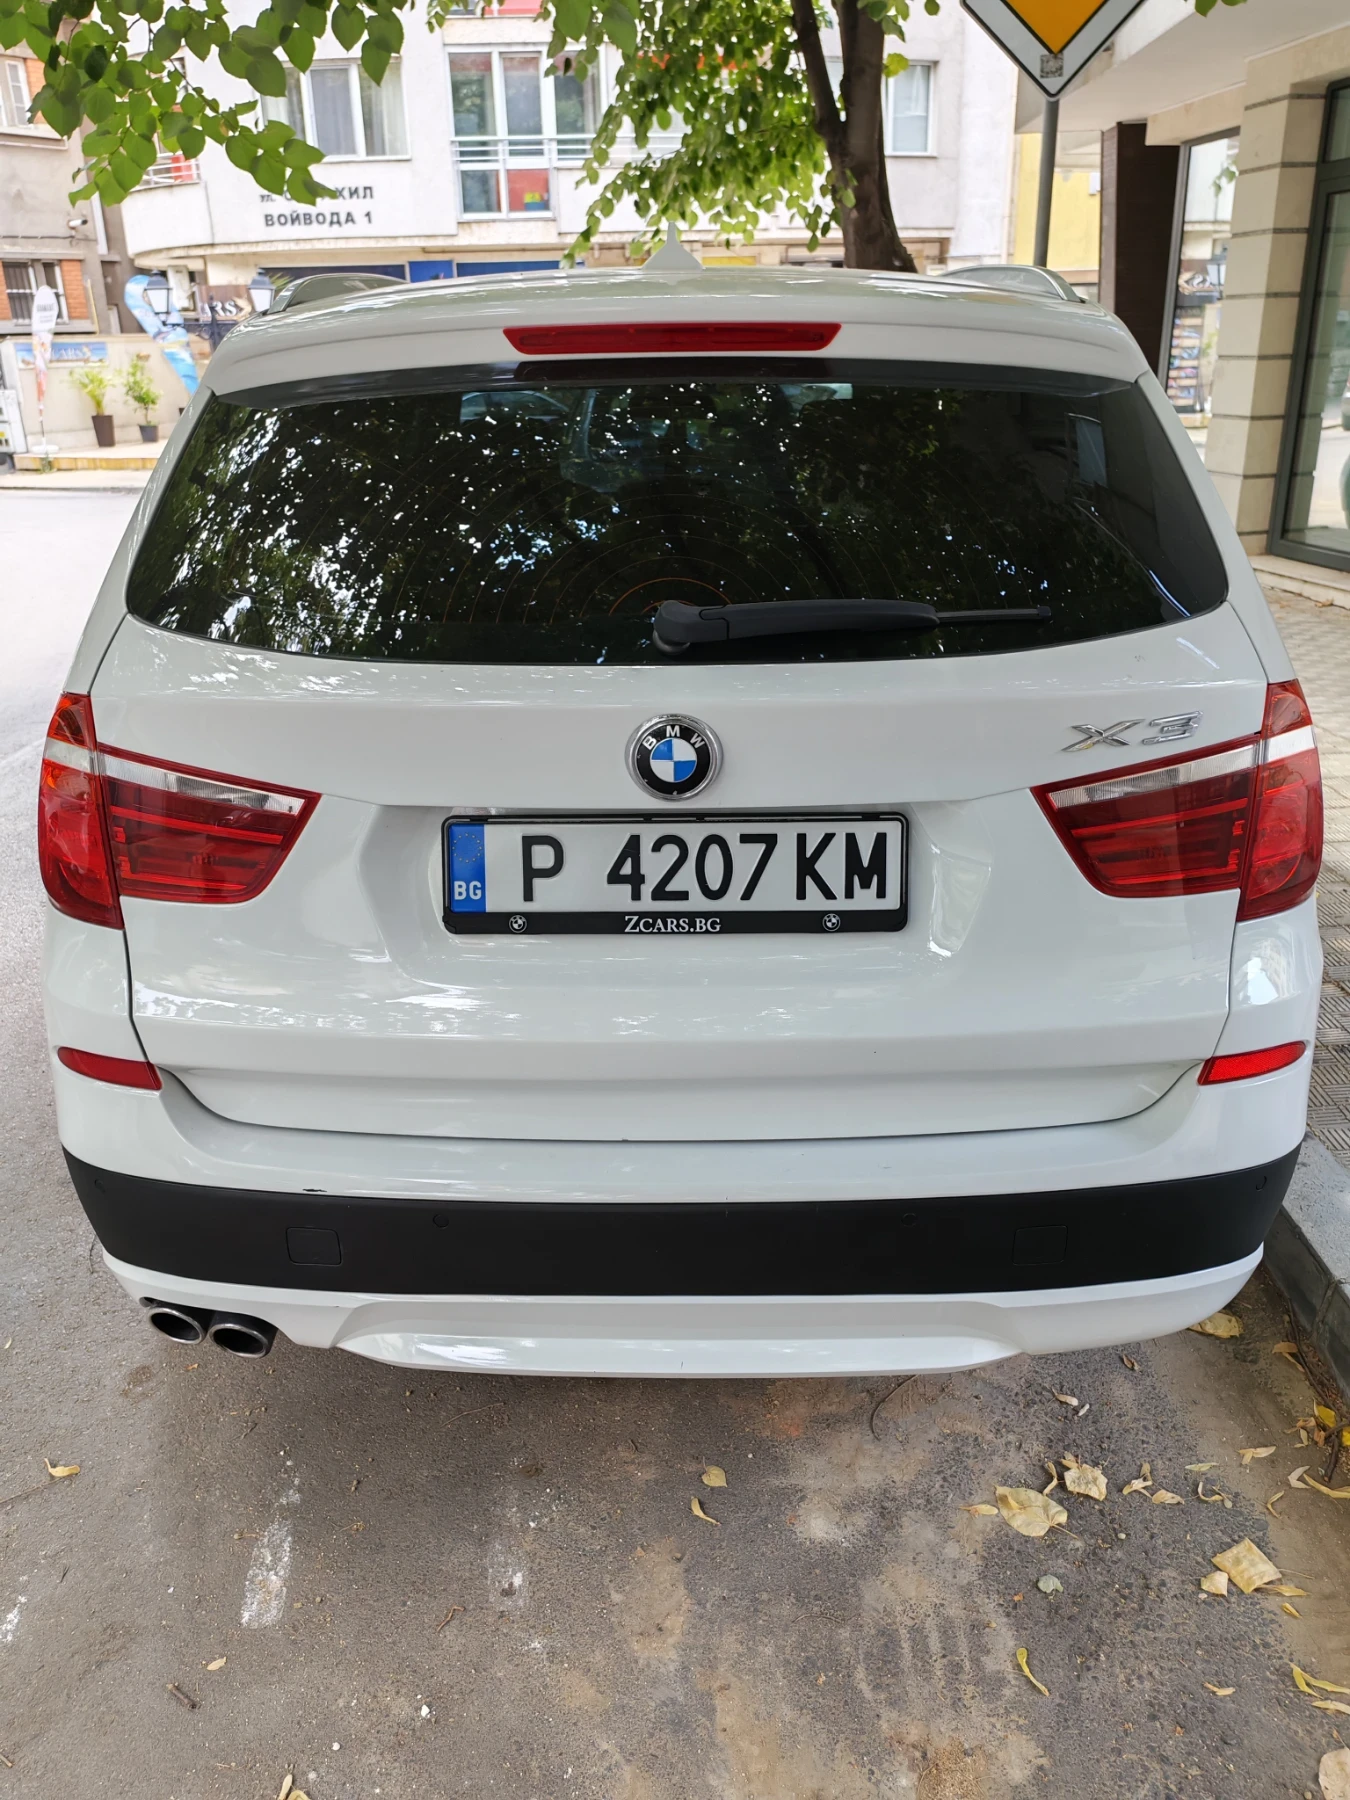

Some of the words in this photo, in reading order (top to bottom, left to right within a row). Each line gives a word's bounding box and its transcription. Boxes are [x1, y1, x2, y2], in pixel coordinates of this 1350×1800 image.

[264, 210, 356, 228] ВОЙВОДА
[364, 211, 373, 224] 1
[642, 725, 705, 750] BMW
[1061, 711, 1204, 752] X3
[522, 834, 565, 903] P
[606, 833, 778, 902] 4207
[796, 832, 888, 901] KM
[453, 881, 482, 901] BG
